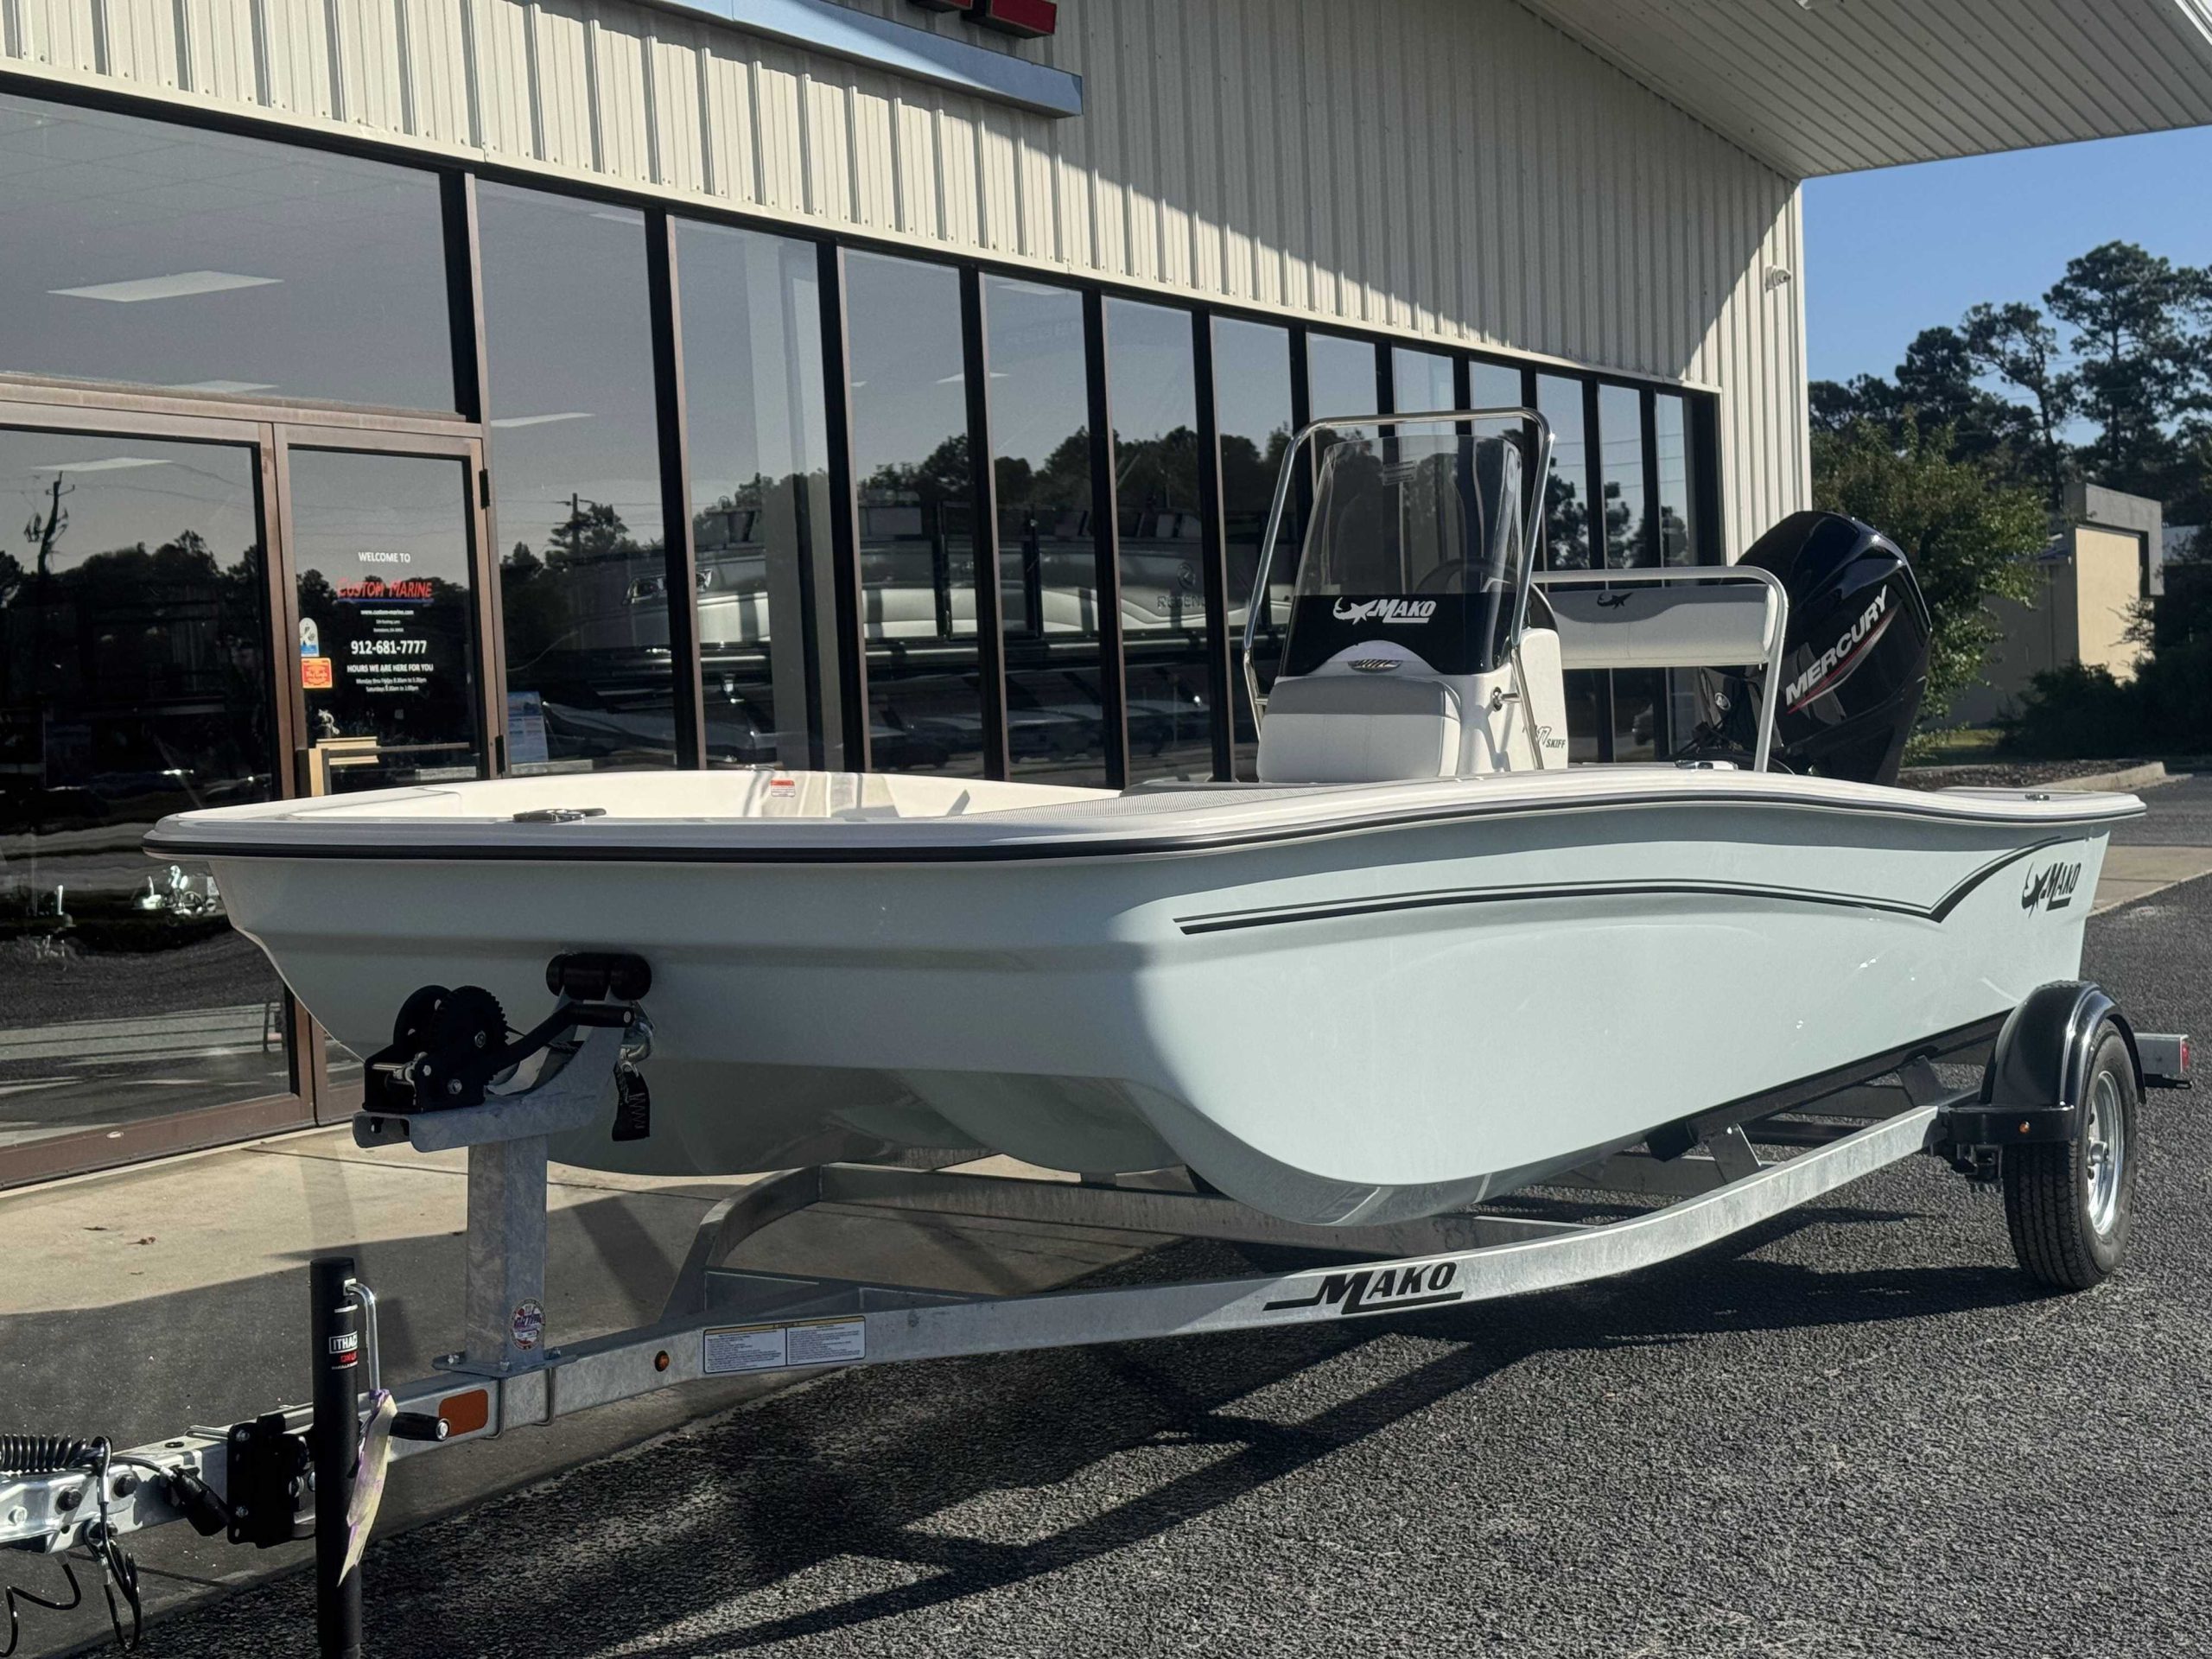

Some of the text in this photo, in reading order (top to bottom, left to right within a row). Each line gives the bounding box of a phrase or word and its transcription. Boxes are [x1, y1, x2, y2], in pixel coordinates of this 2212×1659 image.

[358, 551, 411, 563] WELCOME TO
[1366, 599, 1437, 624] MAKO
[350, 639, 428, 655] 912-681-7777
[1785, 584, 1887, 706] MERCURY
[346, 663, 434, 673] HOURS WE ARE HERE FOR YOU
[1545, 738, 1567, 749] SKIFF
[2039, 861, 2082, 912] MAKO
[1262, 1262, 1465, 1315] MAKO
